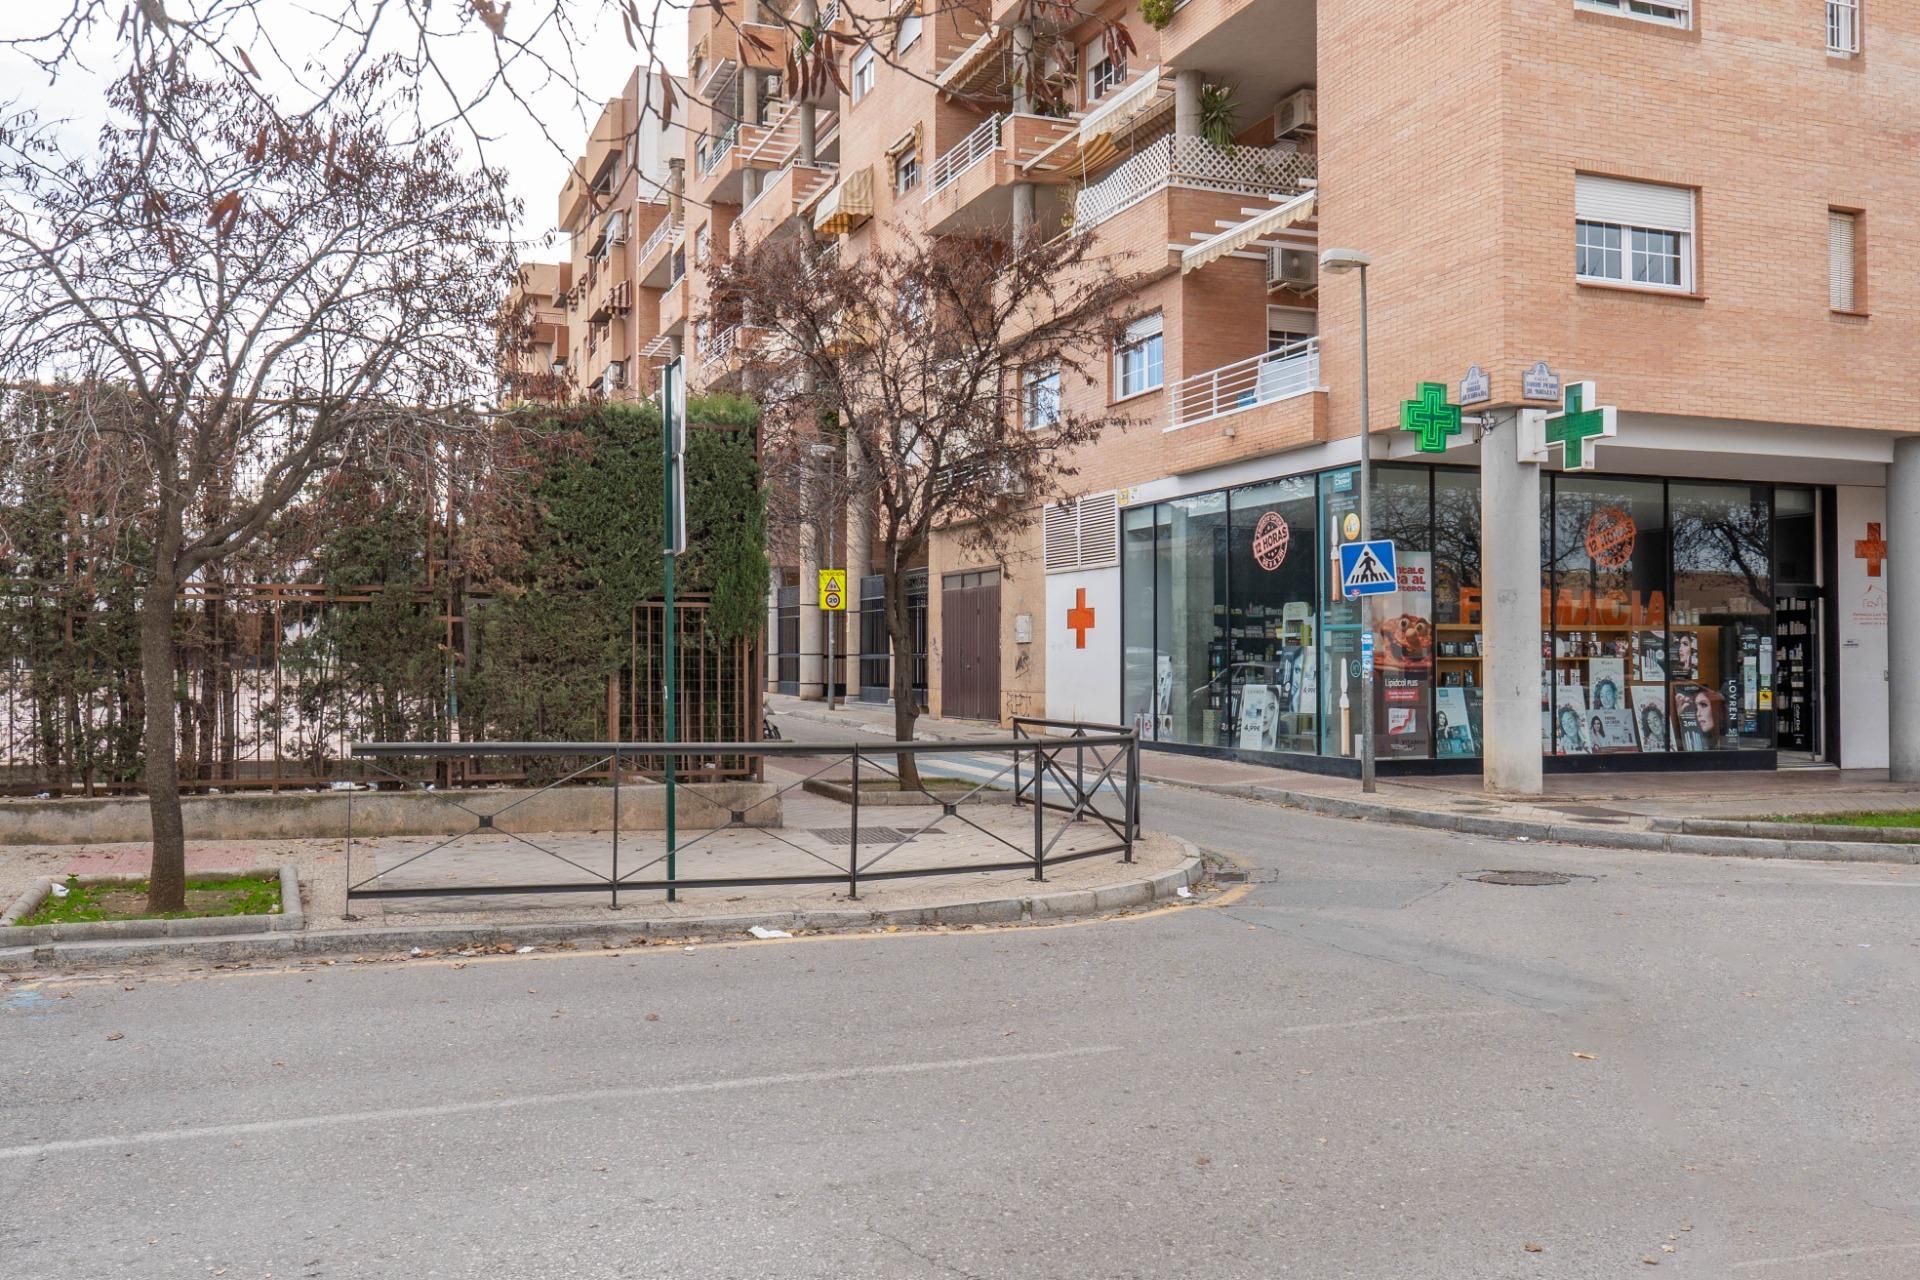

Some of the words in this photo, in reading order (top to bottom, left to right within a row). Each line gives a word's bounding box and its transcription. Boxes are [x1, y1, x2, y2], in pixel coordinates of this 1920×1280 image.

[1262, 526, 1288, 550] HORAS
[1384, 678, 1407, 688] Lipidcol
[1728, 679, 1738, 720] LOVREN
